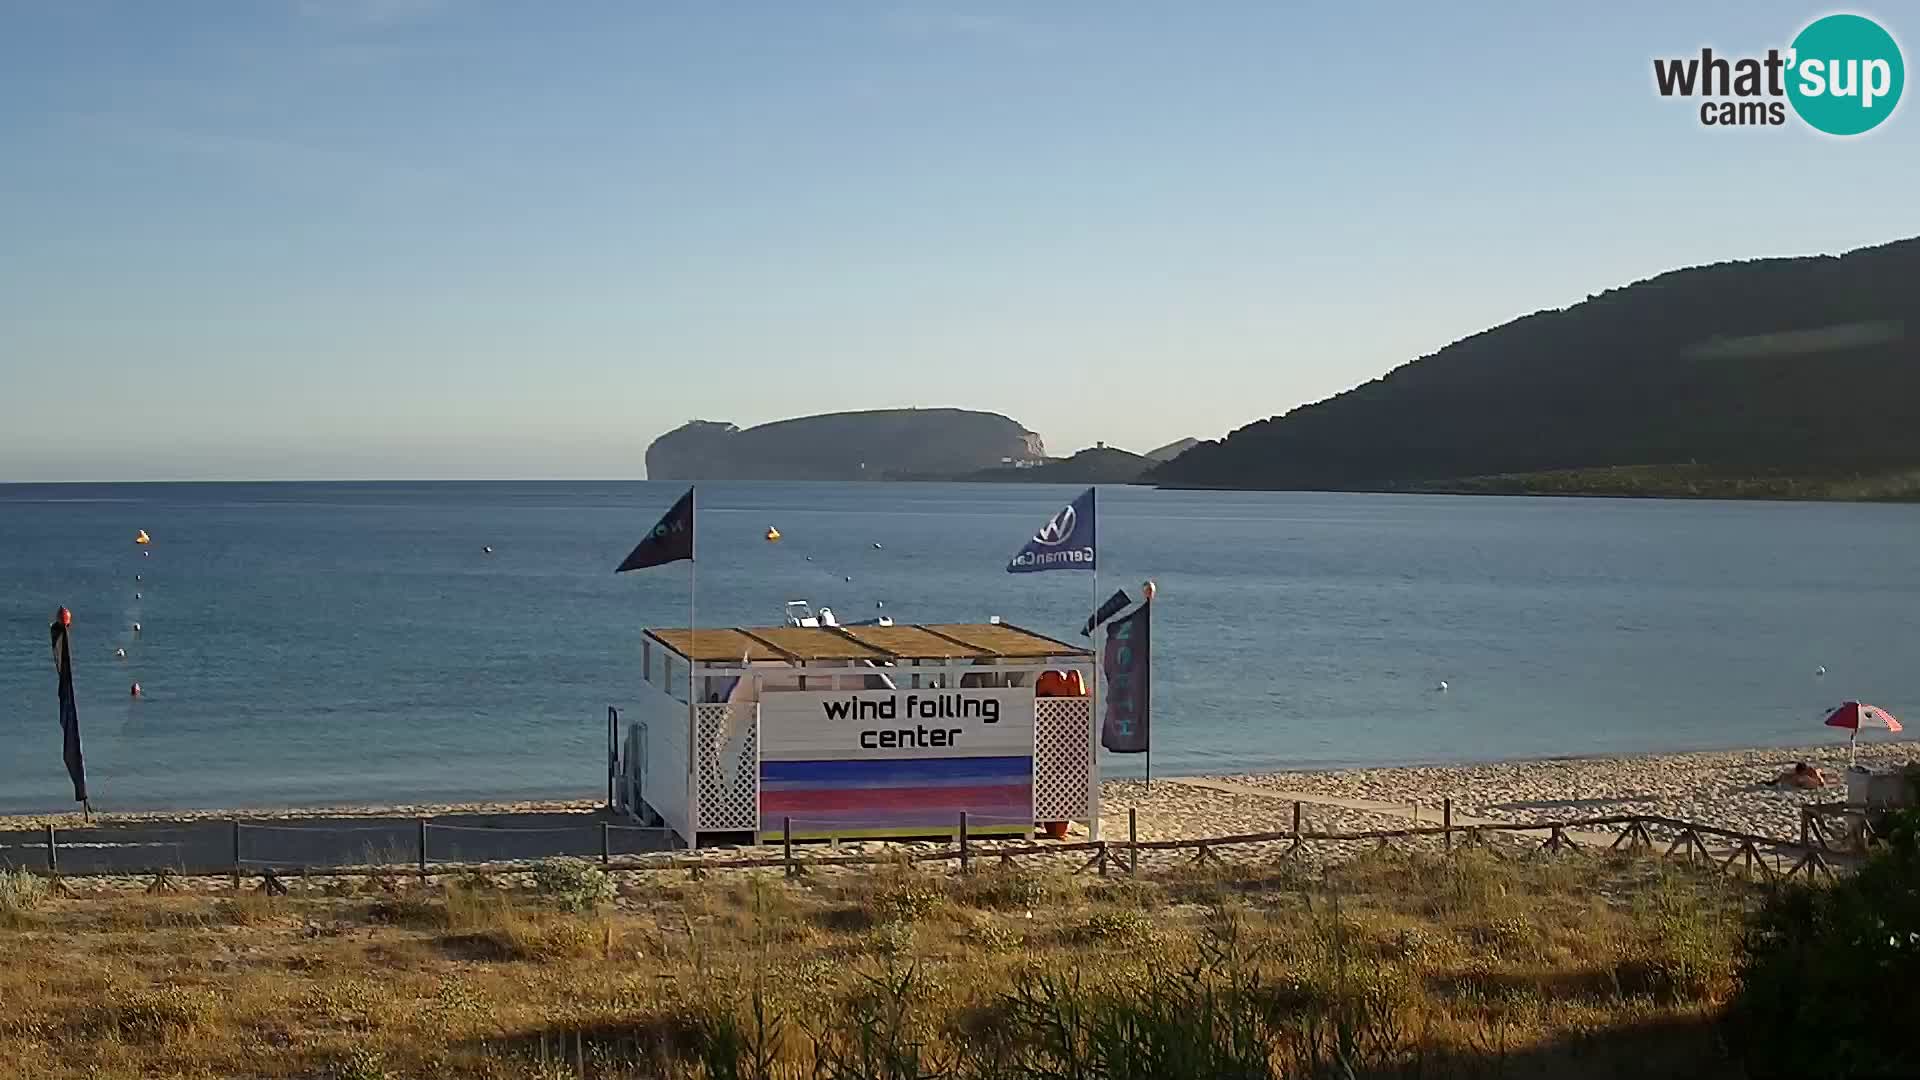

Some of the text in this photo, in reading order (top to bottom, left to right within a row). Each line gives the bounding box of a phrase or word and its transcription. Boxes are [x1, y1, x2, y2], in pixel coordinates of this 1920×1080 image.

[823, 694, 1000, 724] wind foiling
[860, 725, 962, 749] center
